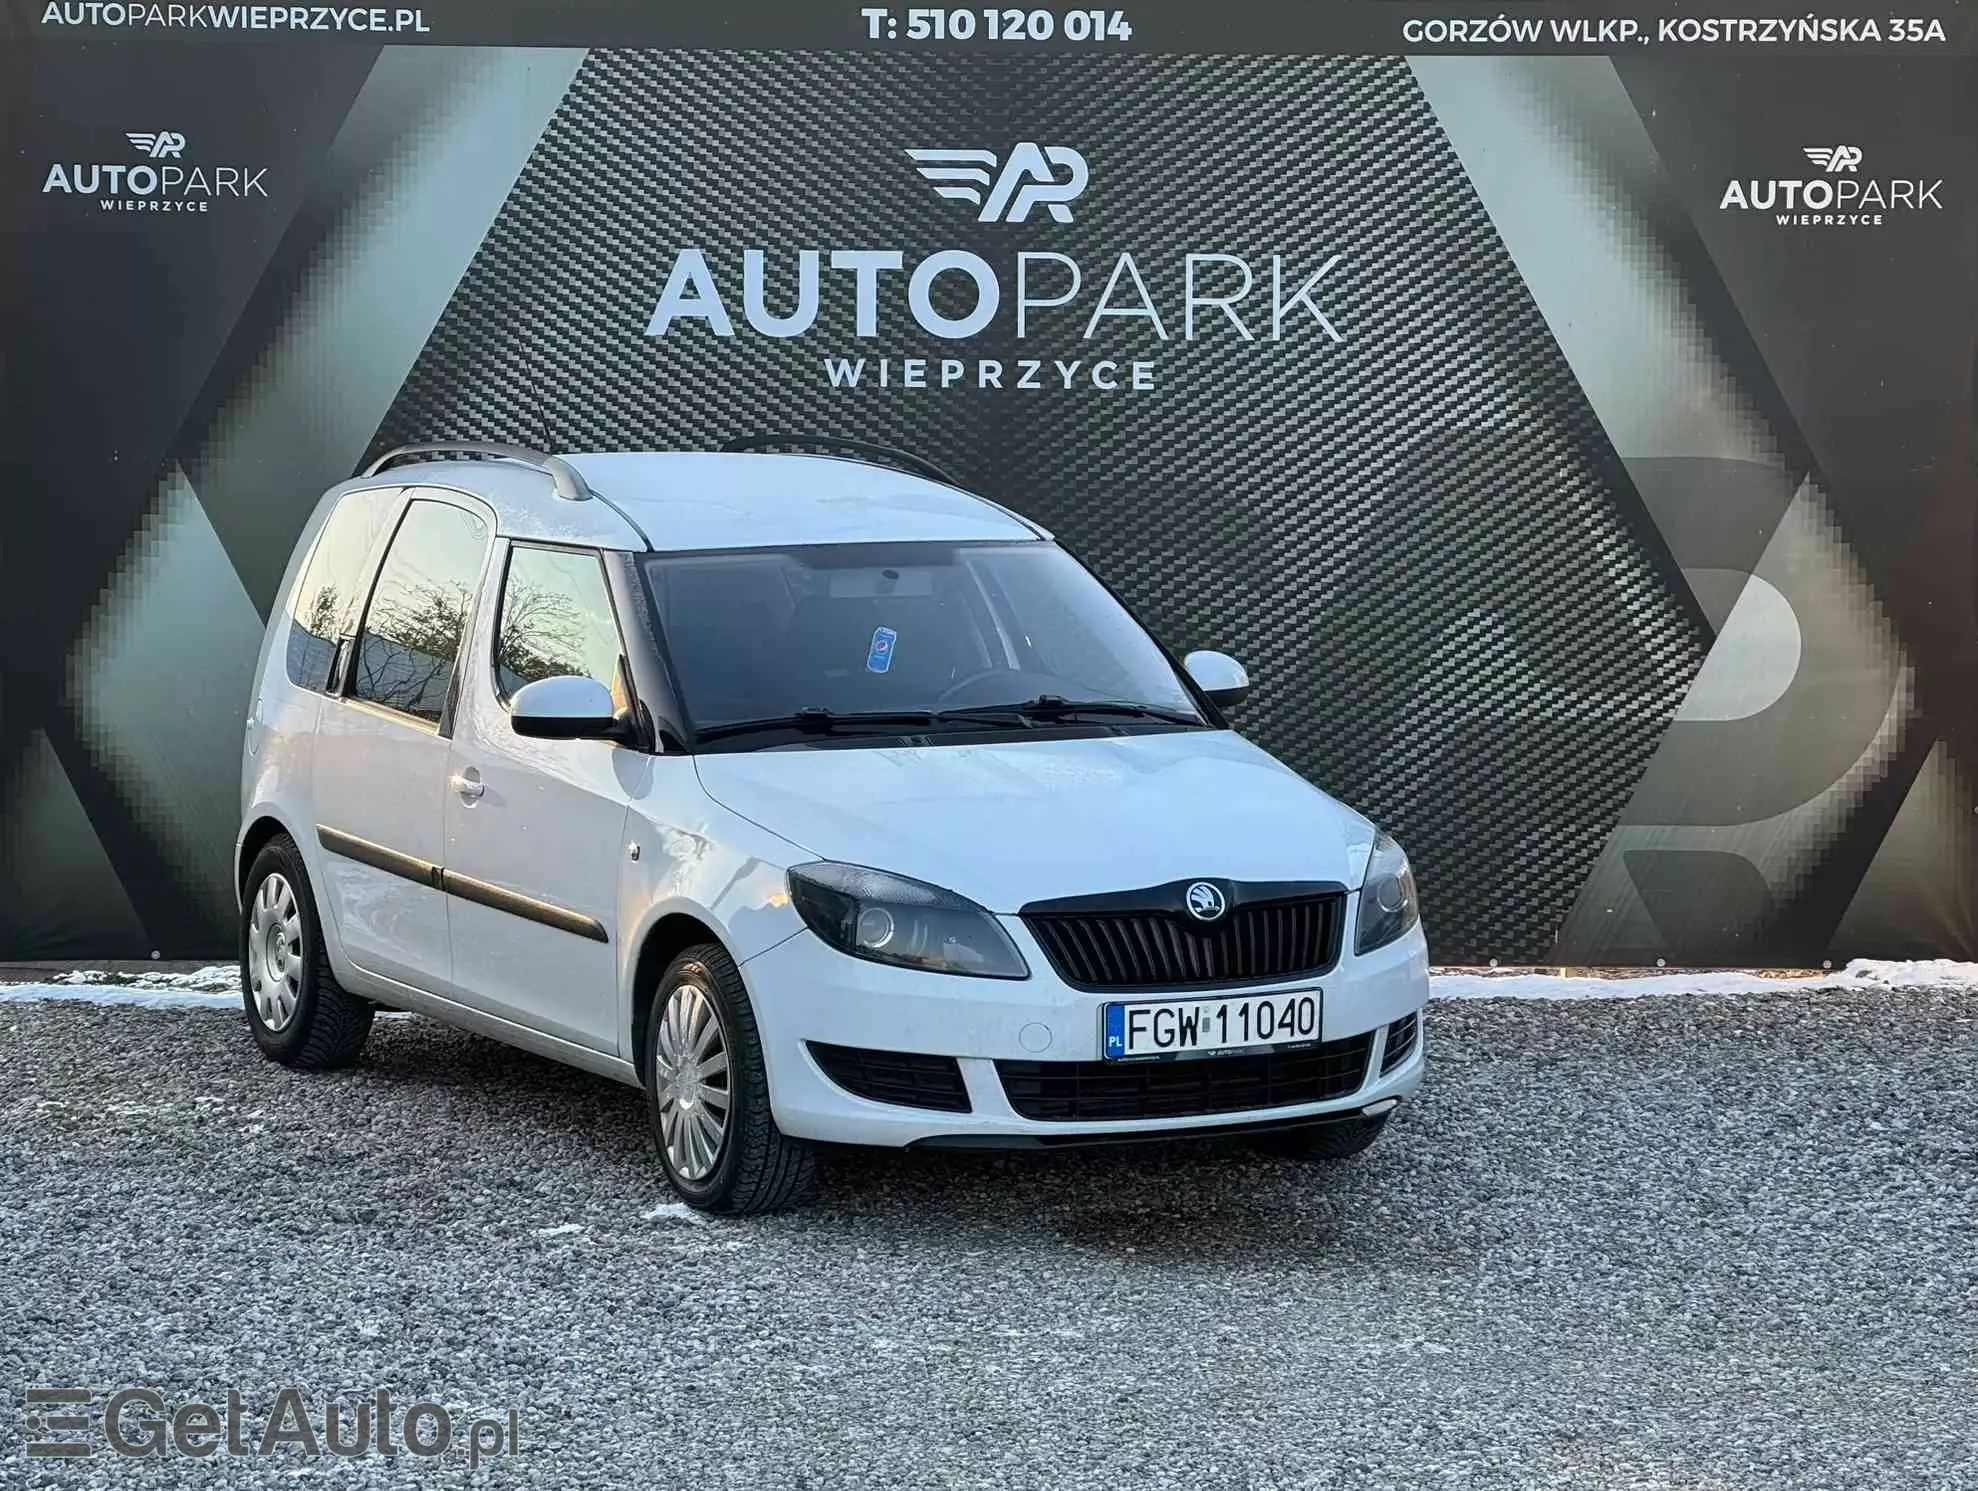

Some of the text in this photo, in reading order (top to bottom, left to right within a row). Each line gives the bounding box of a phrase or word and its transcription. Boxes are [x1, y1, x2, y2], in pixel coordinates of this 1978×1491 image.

[42, 1, 431, 33] AUTOPARKWIEPRZYCE.PL
[861, 8, 1133, 41] T: 510 120 014
[1402, 12, 1947, 45] GORZÓW WLKP., KOSTRZYŃSKA 35A
[42, 163, 269, 197] AUTOPARK
[1719, 179, 1943, 210] AUTOPARK
[100, 199, 209, 213] WIEPRZYCE
[1775, 214, 1883, 226] WIEPRZYCE
[645, 248, 1344, 343] AUTOPARK
[824, 357, 1156, 390] WIEPRZYCE
[1128, 996, 1315, 1050] FGW 11040
[1108, 1036, 1122, 1047] PL
